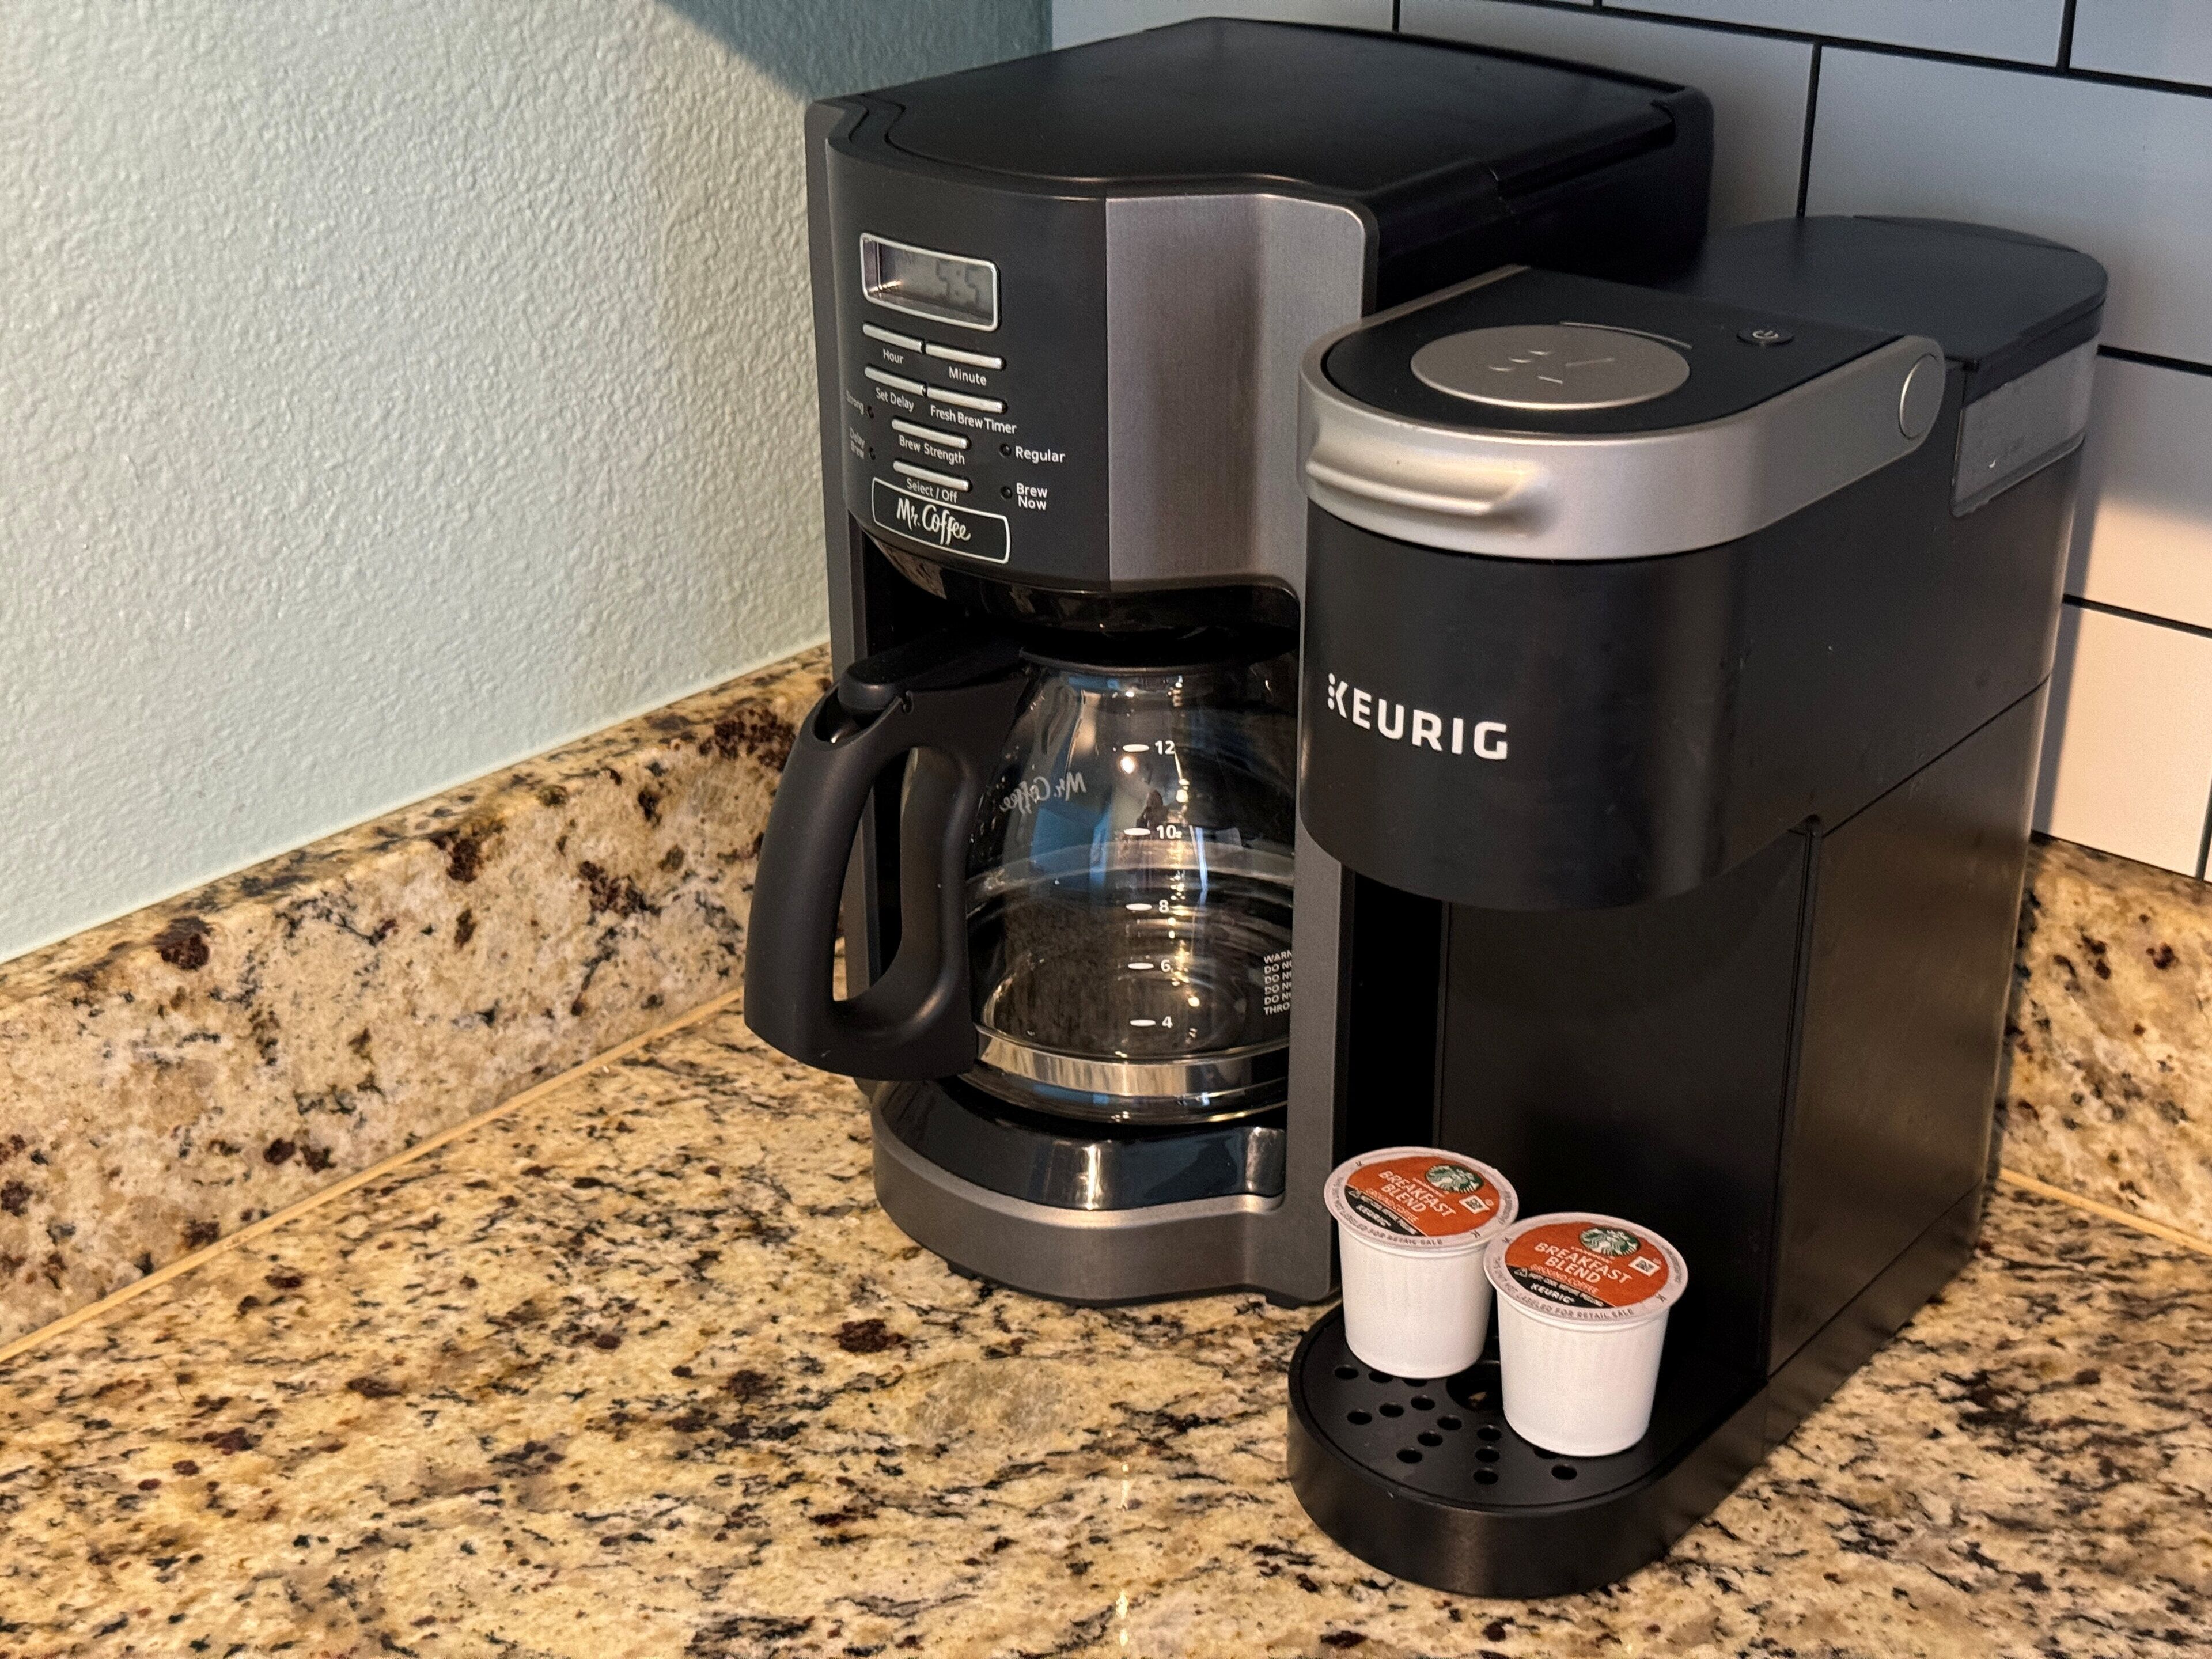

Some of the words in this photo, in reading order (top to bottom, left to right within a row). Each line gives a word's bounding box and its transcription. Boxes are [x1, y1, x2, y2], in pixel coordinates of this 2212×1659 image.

[882, 347, 904, 365] Hour
[949, 366, 987, 386] Minute
[876, 387, 889, 403] Set
[890, 392, 914, 413] Delay
[930, 404, 956, 423] Fresh
[957, 413, 983, 430] Brew
[983, 417, 1017, 434] Timer
[899, 434, 921, 452] Brew
[923, 443, 965, 465] Strength
[1015, 446, 1066, 464] Regular
[906, 478, 934, 496] Select
[941, 489, 958, 503] Off
[1016, 483, 1048, 498] Brew
[1018, 495, 1047, 510] Now
[896, 498, 921, 531] Mr.
[922, 504, 971, 546] Coffee
[1327, 672, 1508, 760] KEURIG
[1155, 740, 1175, 755] 12
[1156, 825, 1176, 839] 10
[1158, 900, 1169, 913] 8
[1160, 960, 1171, 972] 6
[1264, 963, 1279, 974] DO
[1264, 974, 1279, 984] DO
[1264, 984, 1279, 995] DO
[1264, 994, 1279, 1005] DO
[1162, 1017, 1173, 1028] 4
[1378, 1171, 1457, 1217] BREAKFAST
[1381, 1183, 1427, 1213] BLEND
[1534, 1242, 1633, 1283] BREAKFAST
[1544, 1256, 1601, 1283] BLEND
[1530, 1283, 1575, 1304] KEURIG
[1555, 1308, 1574, 1317] FOR
[1577, 1310, 1610, 1320] RETAIL
[1611, 1308, 1634, 1317] SALE
